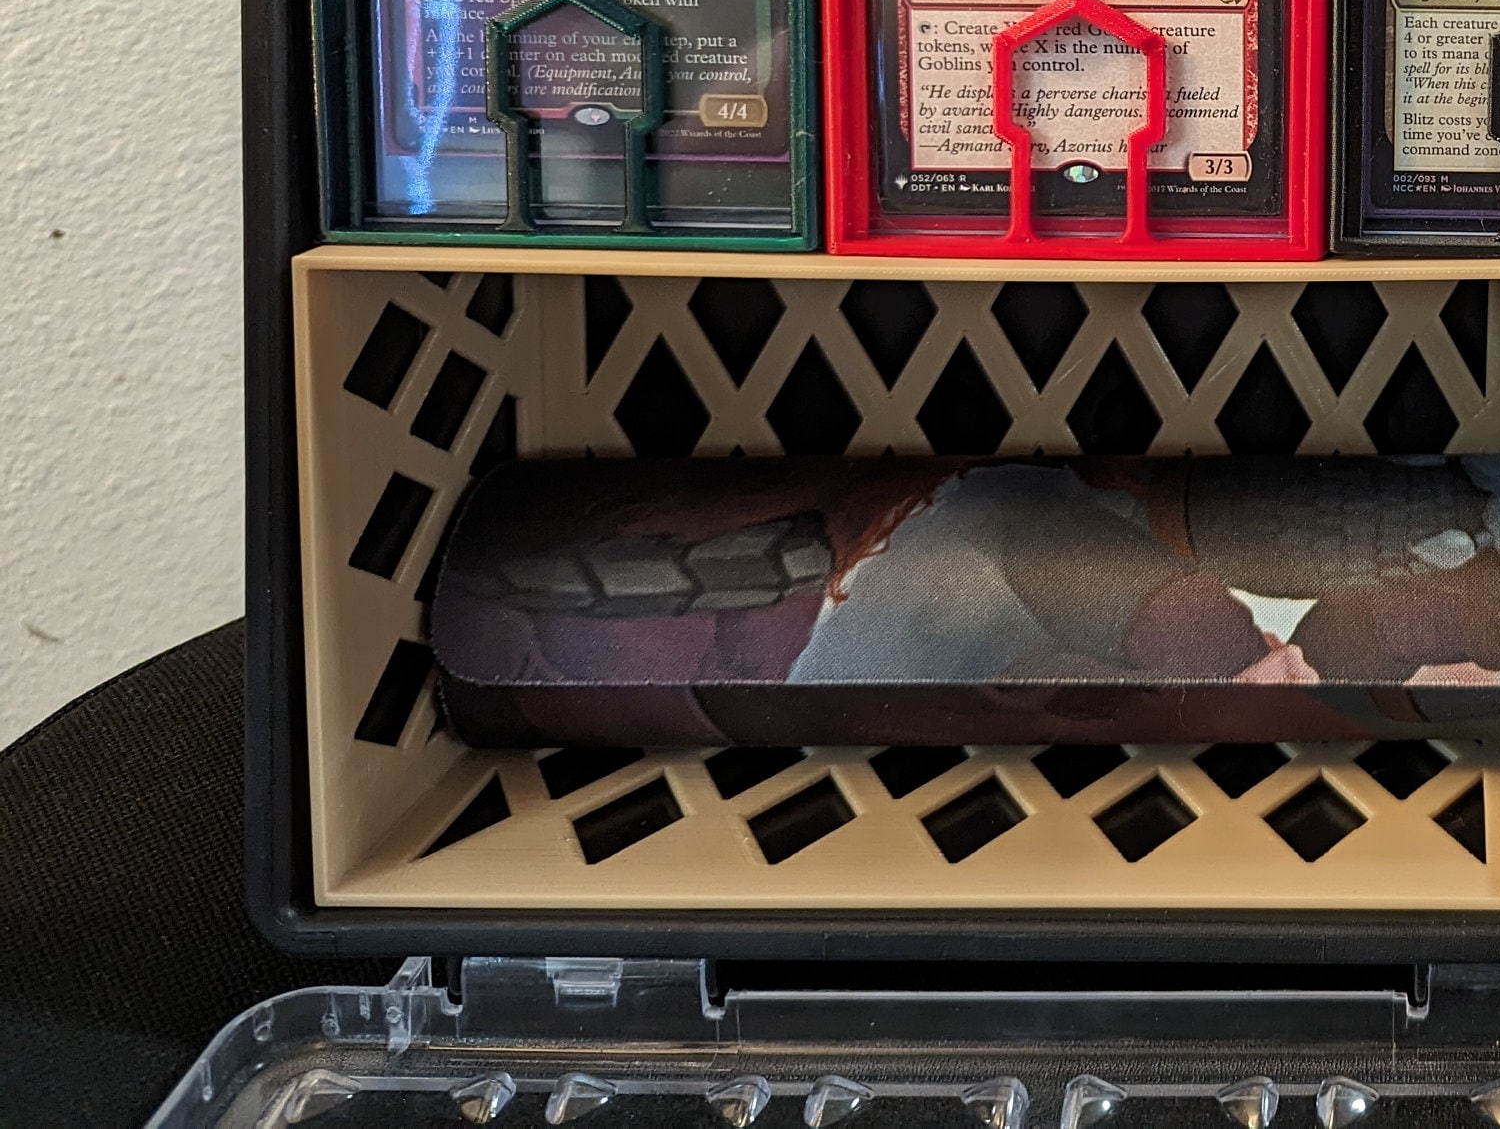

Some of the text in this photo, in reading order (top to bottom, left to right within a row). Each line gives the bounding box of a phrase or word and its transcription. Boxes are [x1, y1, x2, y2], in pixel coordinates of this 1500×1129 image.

[944, 21, 998, 36] Create
[1404, 16, 1432, 30] Each
[1435, 17, 1499, 31] creature
[581, 36, 619, 49] your
[918, 39, 976, 56] tokens,
[1436, 33, 1483, 48] greater
[572, 48, 748, 65] each creature
[1441, 49, 1480, 60] mana
[918, 56, 1086, 72] Goblins control.
[1403, 61, 1431, 76] spell
[527, 64, 752, 84] (Equipment, control,
[1453, 77, 1475, 90] this
[1036, 86, 1221, 104] perverse fueled
[718, 102, 748, 120] 4/4
[1011, 102, 1143, 121] Highly dangerous.
[918, 120, 951, 135] civil
[1403, 113, 1434, 126] Blitz
[1438, 114, 1472, 127] costs
[1403, 129, 1434, 142] time
[1054, 139, 1113, 154] Azorius
[1402, 144, 1470, 157] command
[1205, 159, 1233, 175] 3/3
[911, 174, 967, 183] 052/063 R
[1393, 174, 1449, 183] 002/093 M
[911, 183, 931, 192] DDT
[941, 183, 956, 192] EN
[1166, 184, 1247, 194] Wizards of the Coast
[1393, 184, 1414, 193] NCC
